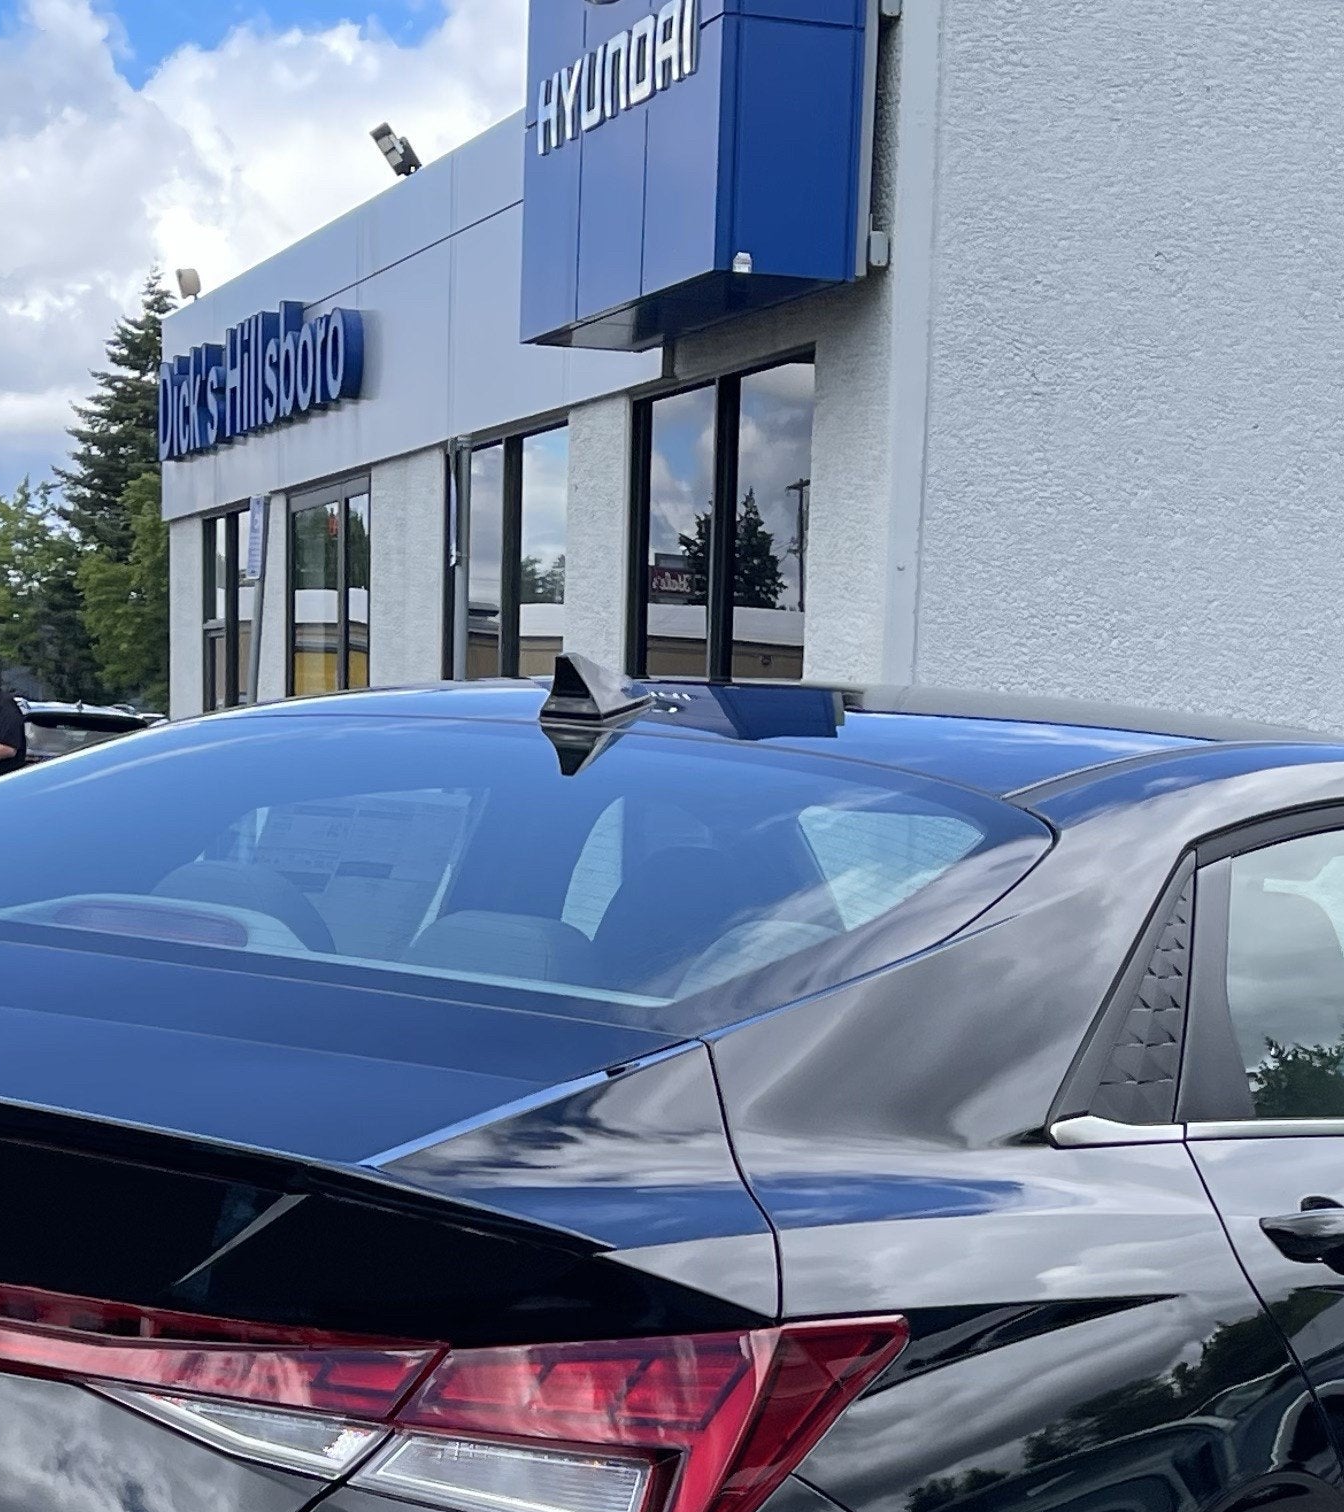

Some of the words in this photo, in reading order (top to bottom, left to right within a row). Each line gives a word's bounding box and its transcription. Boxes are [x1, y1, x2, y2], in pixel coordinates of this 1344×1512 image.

[537, 0, 697, 156] HYUNDAI
[159, 343, 219, 462] Dick's
[225, 301, 346, 438] Hillsboro
